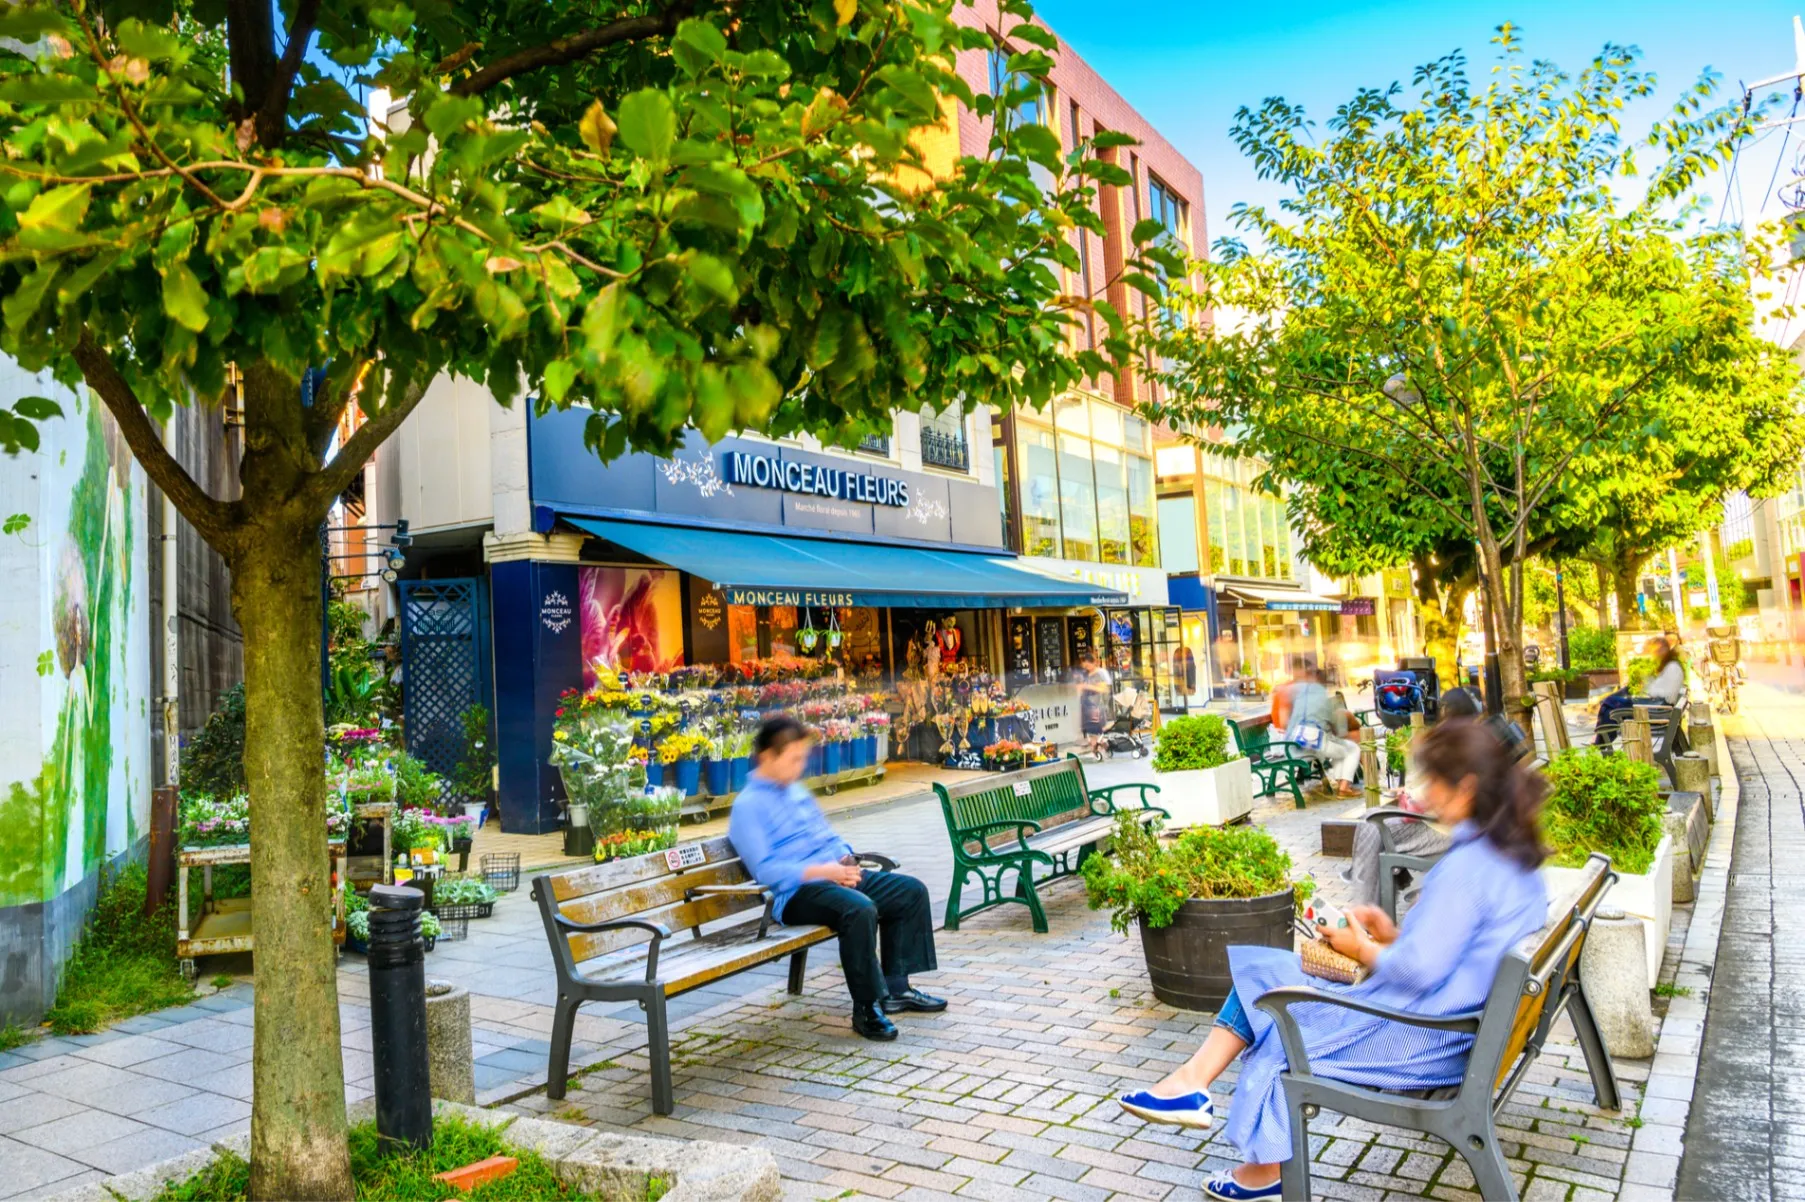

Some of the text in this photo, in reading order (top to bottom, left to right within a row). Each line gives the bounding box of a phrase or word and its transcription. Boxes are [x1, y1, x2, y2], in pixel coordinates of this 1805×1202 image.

[733, 451, 910, 507] MONCEAU FLEURS
[734, 591, 853, 606] MONCEAU FLEURS
